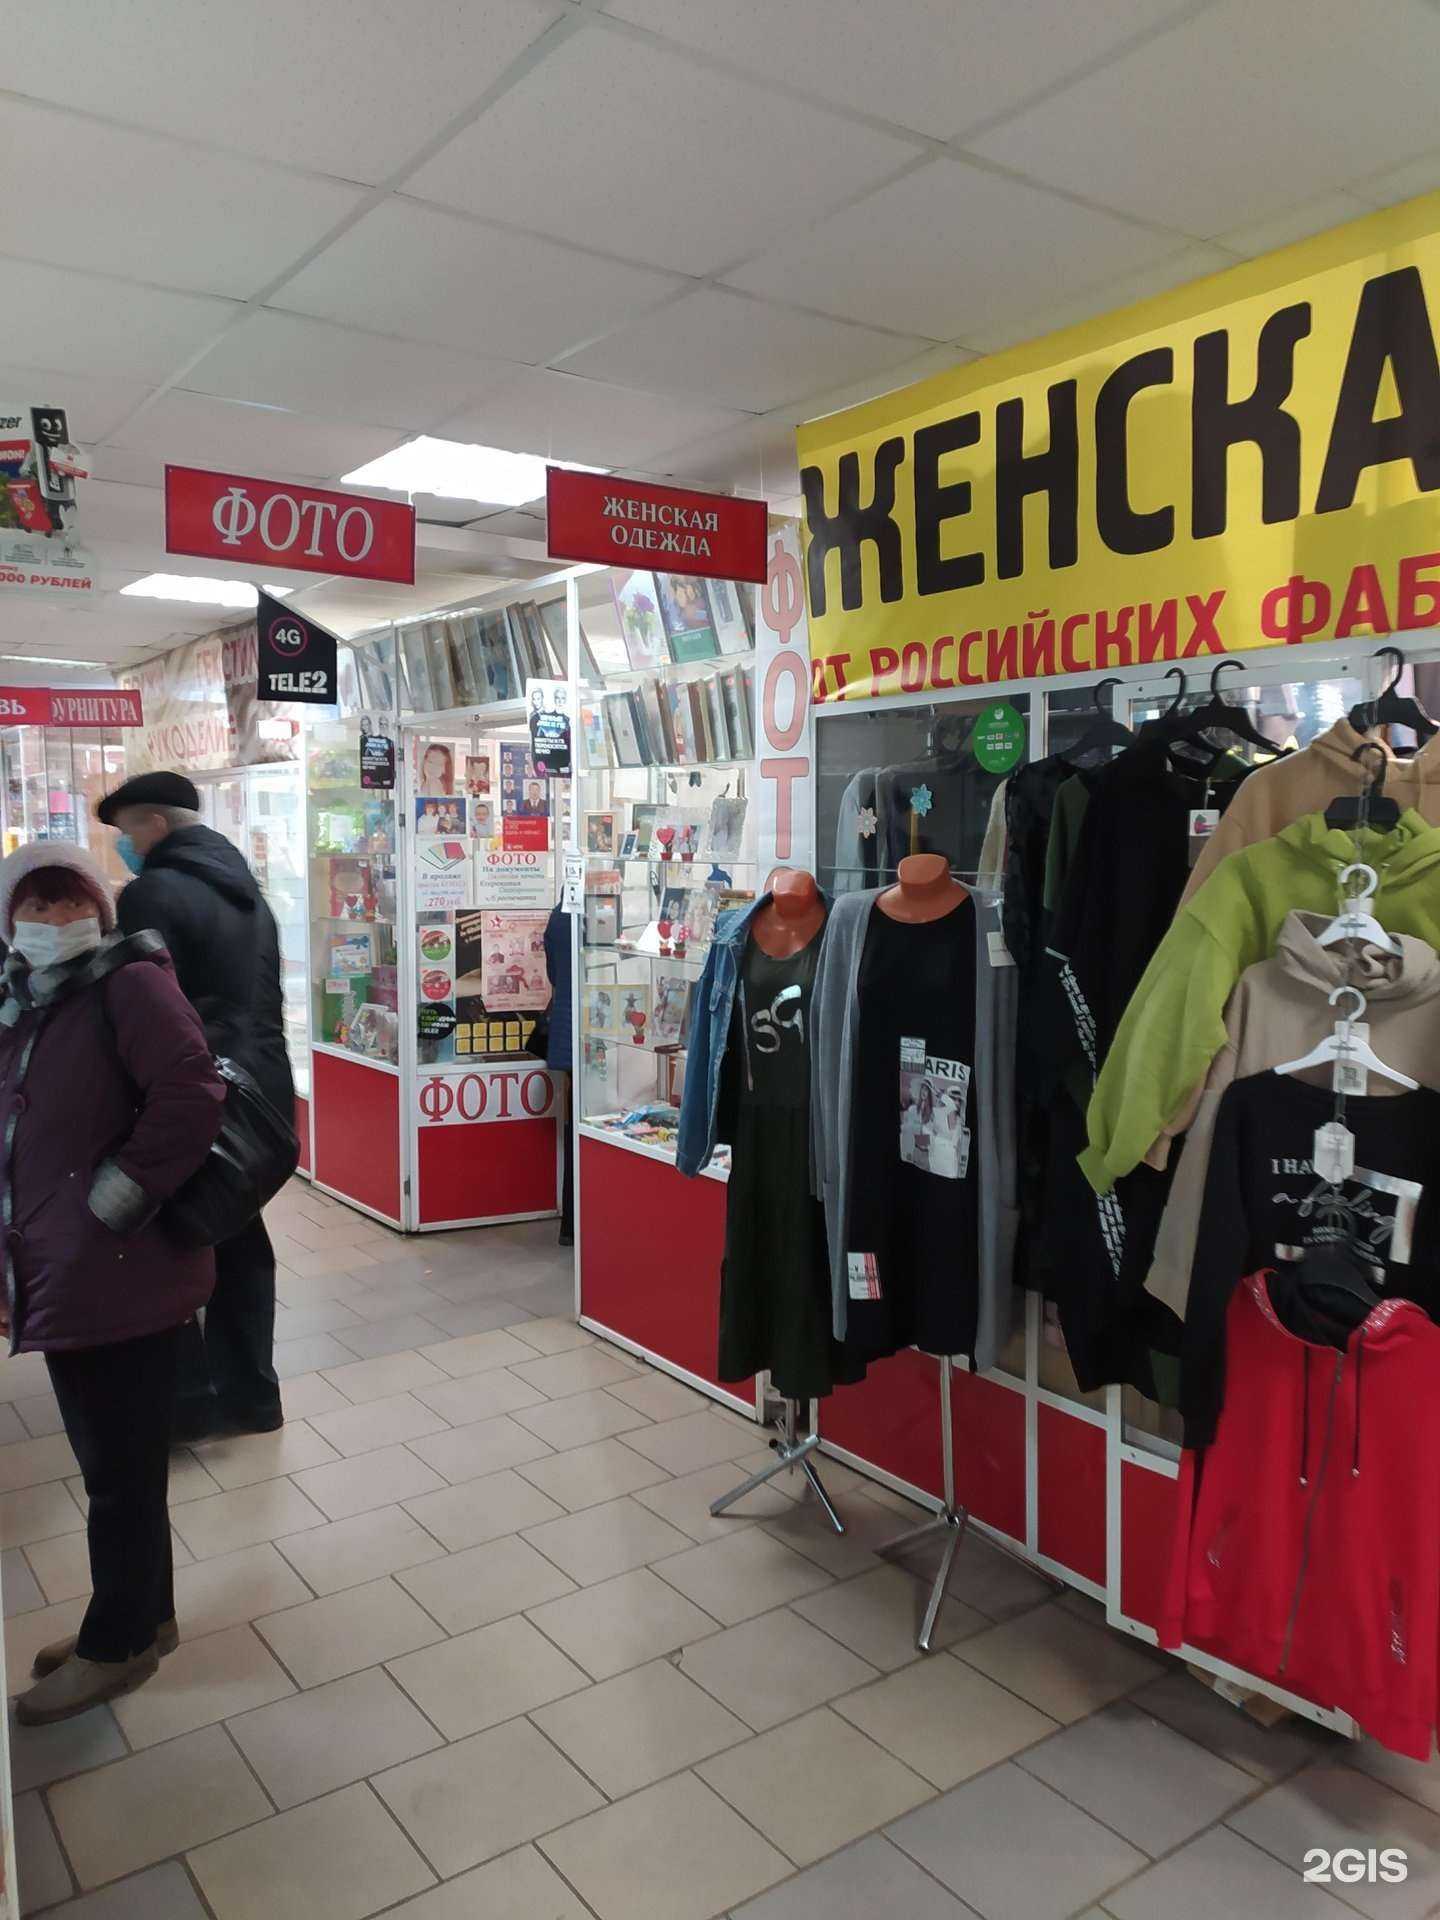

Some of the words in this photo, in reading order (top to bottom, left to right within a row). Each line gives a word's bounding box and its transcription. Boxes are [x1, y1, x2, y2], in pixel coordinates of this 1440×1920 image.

[801, 265, 1440, 618] ЖЕНСКА
[212, 487, 374, 562] ФОТО
[602, 495, 719, 532] ЖЕНСКАЯ
[611, 525, 712, 557] ОДЕЖДА
[30, 575, 92, 589] РУБЛЕЙ
[275, 627, 302, 645] 4G
[868, 590, 1227, 697] РОССИЙСКИХ
[1261, 552, 1440, 644] ФАБ
[268, 670, 328, 695] TELE2
[761, 540, 809, 893] ФОТ
[486, 852, 537, 865] ФОТО
[924, 1058, 967, 1082] ARIS
[419, 1070, 554, 1122] ФОТО
[1284, 1158, 1315, 1175] HA
